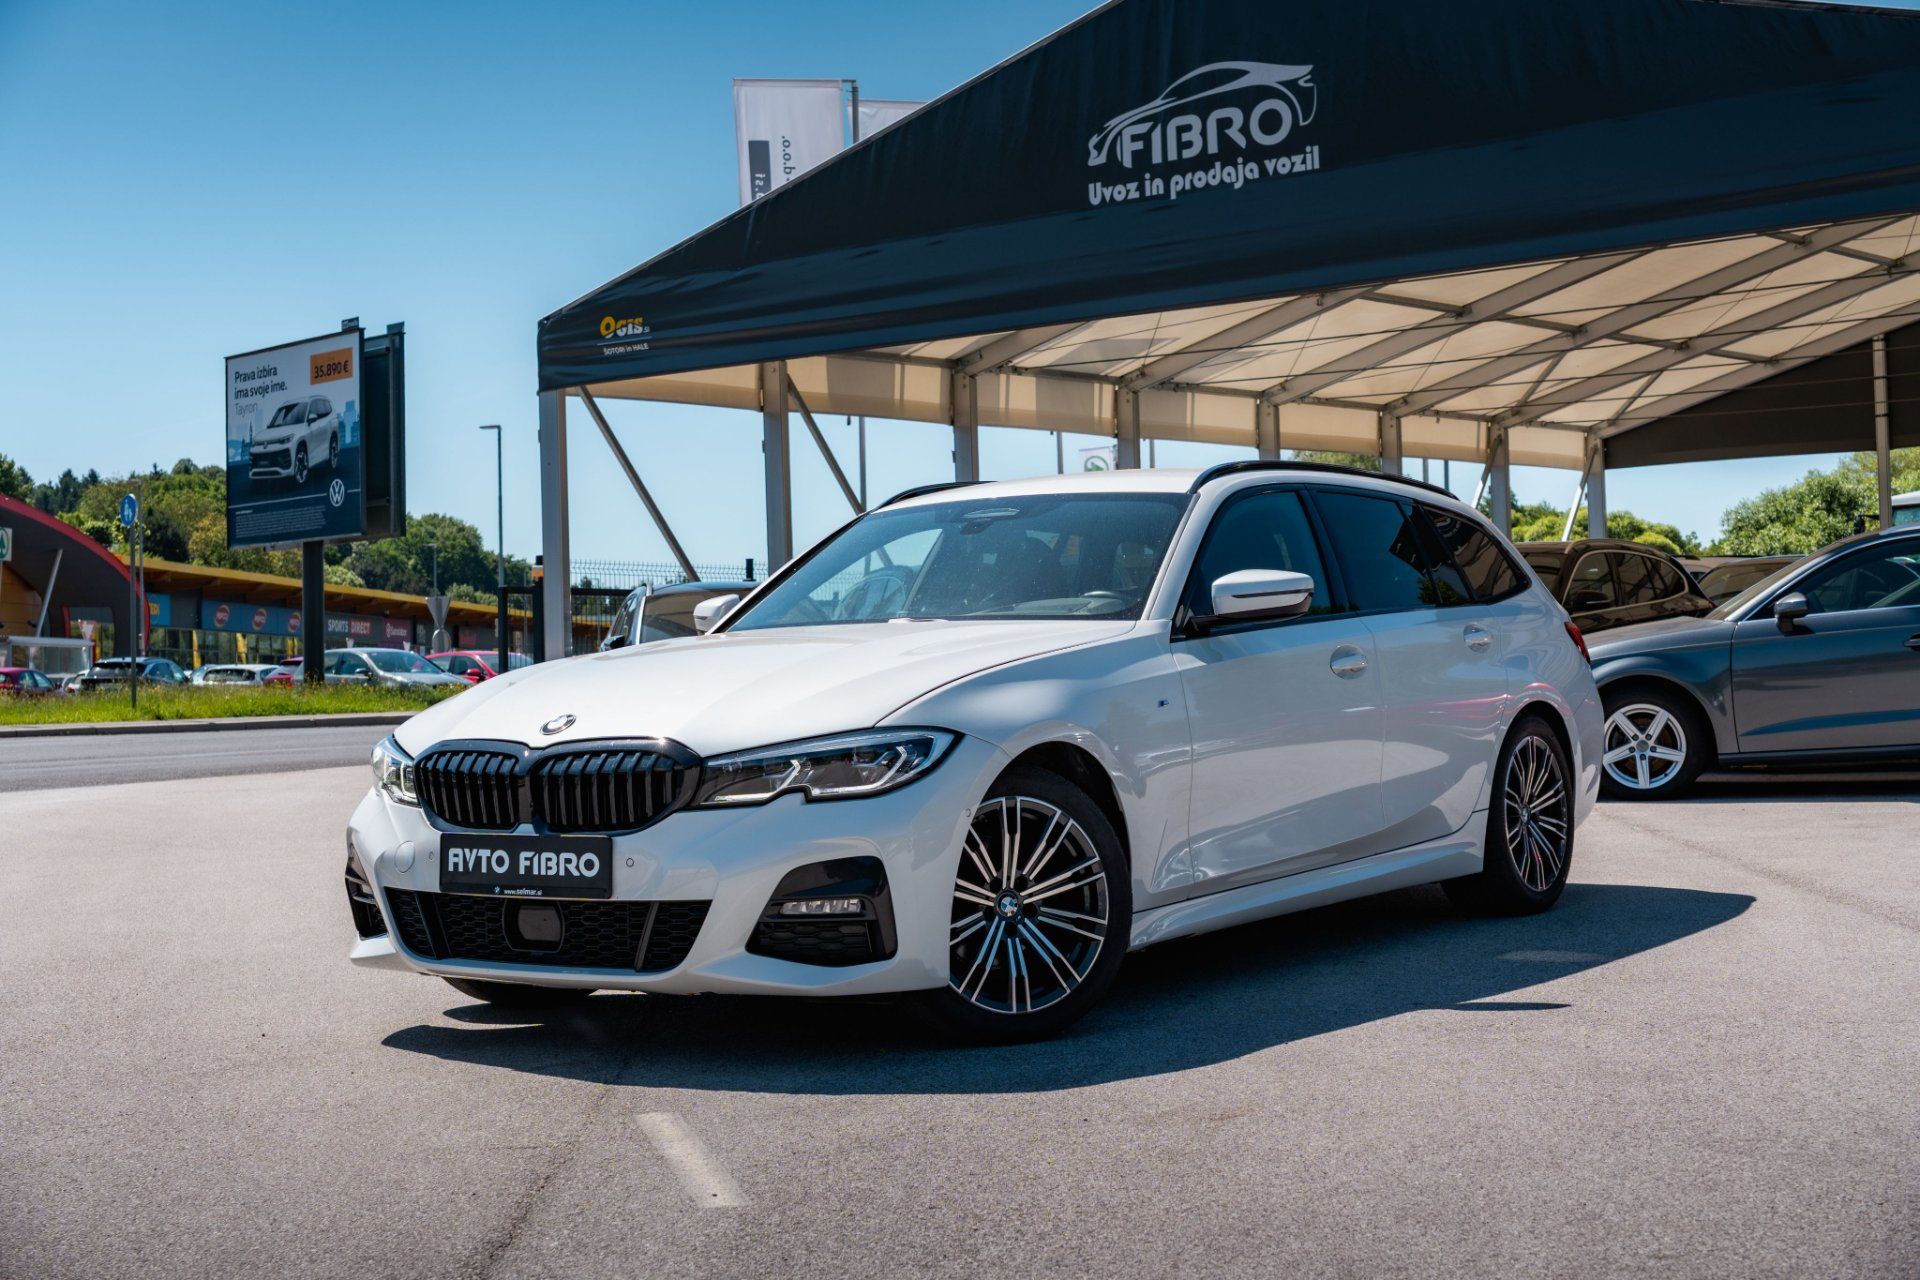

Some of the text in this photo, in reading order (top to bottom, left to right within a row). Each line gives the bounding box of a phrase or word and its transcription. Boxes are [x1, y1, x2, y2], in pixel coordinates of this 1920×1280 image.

[1117, 98, 1293, 168] FIBRO
[1088, 145, 1320, 206] Uvoz in prodaja vozil
[234, 364, 278, 384] Prava izbira
[314, 363, 342, 379] 35.890
[234, 380, 288, 400] ima svoje ime.
[328, 619, 349, 633] SPORTS
[448, 847, 600, 878] AVTO FIBRO
